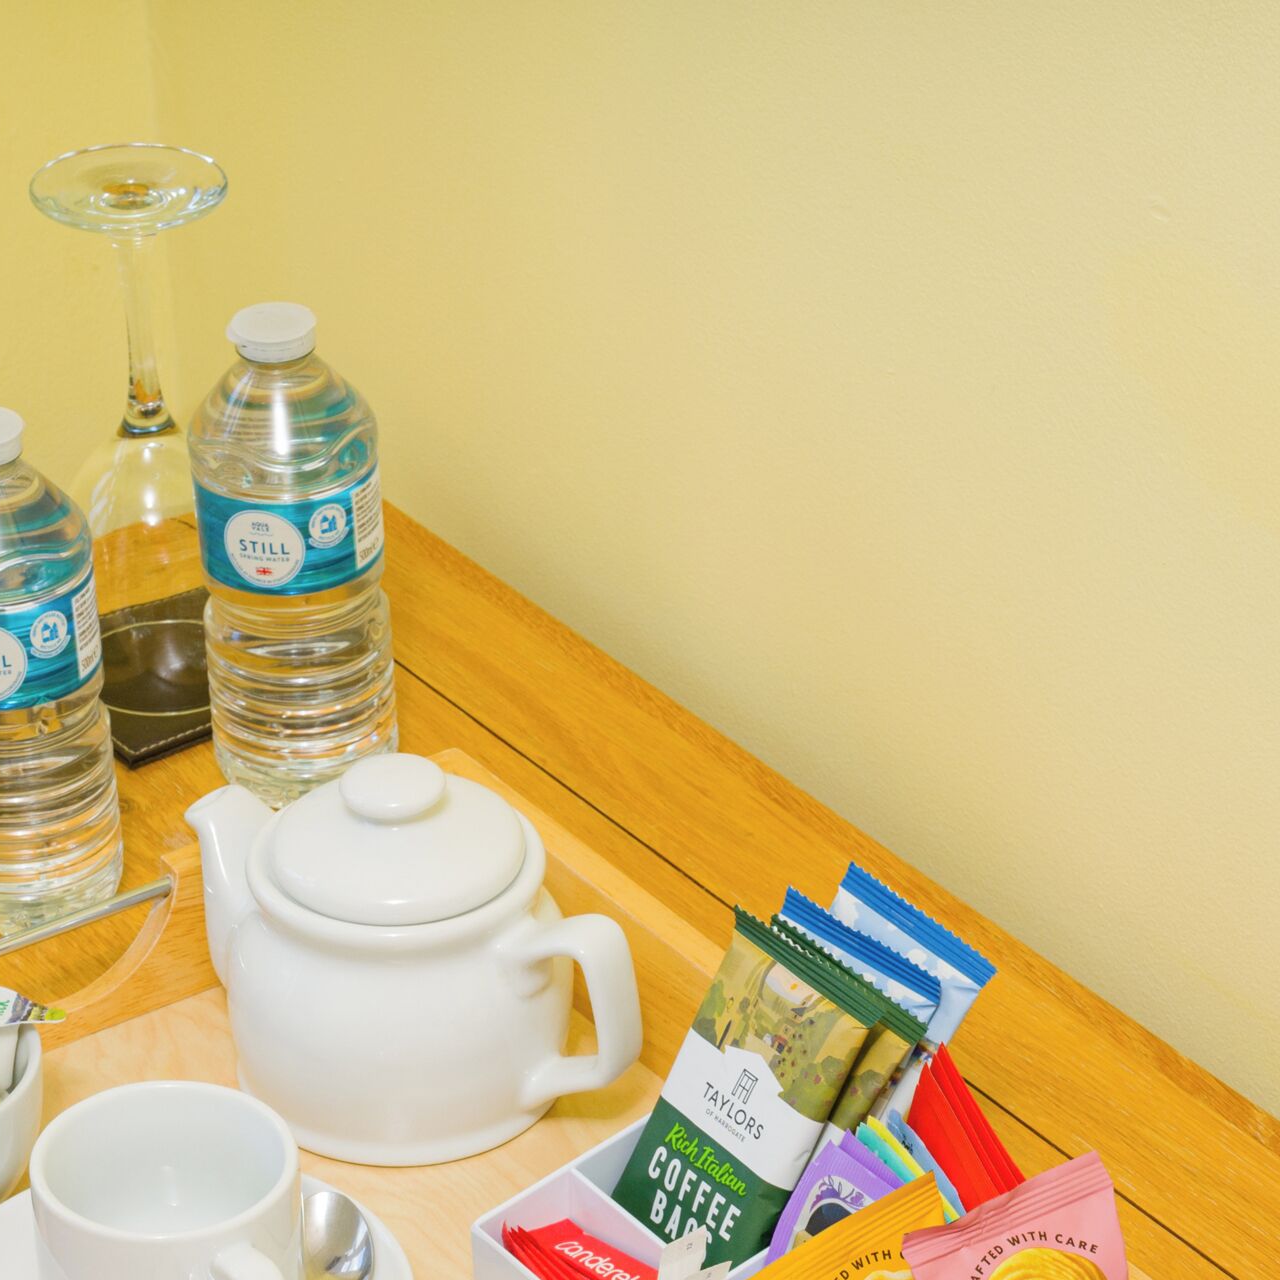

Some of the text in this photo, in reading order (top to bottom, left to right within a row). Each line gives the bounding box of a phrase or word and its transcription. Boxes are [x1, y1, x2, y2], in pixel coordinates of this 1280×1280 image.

[239, 539, 291, 556] STILL
[240, 552, 264, 562] SPRING
[702, 1082, 764, 1140] TAYLORS
[705, 1108, 746, 1143] OF HARROGATE
[664, 1122, 748, 1197] Rich Italian
[648, 1146, 742, 1242] COFFEE
[1007, 1231, 1048, 1246] WITH
[1055, 1233, 1099, 1254] CARE
[851, 1249, 892, 1270] WITH
